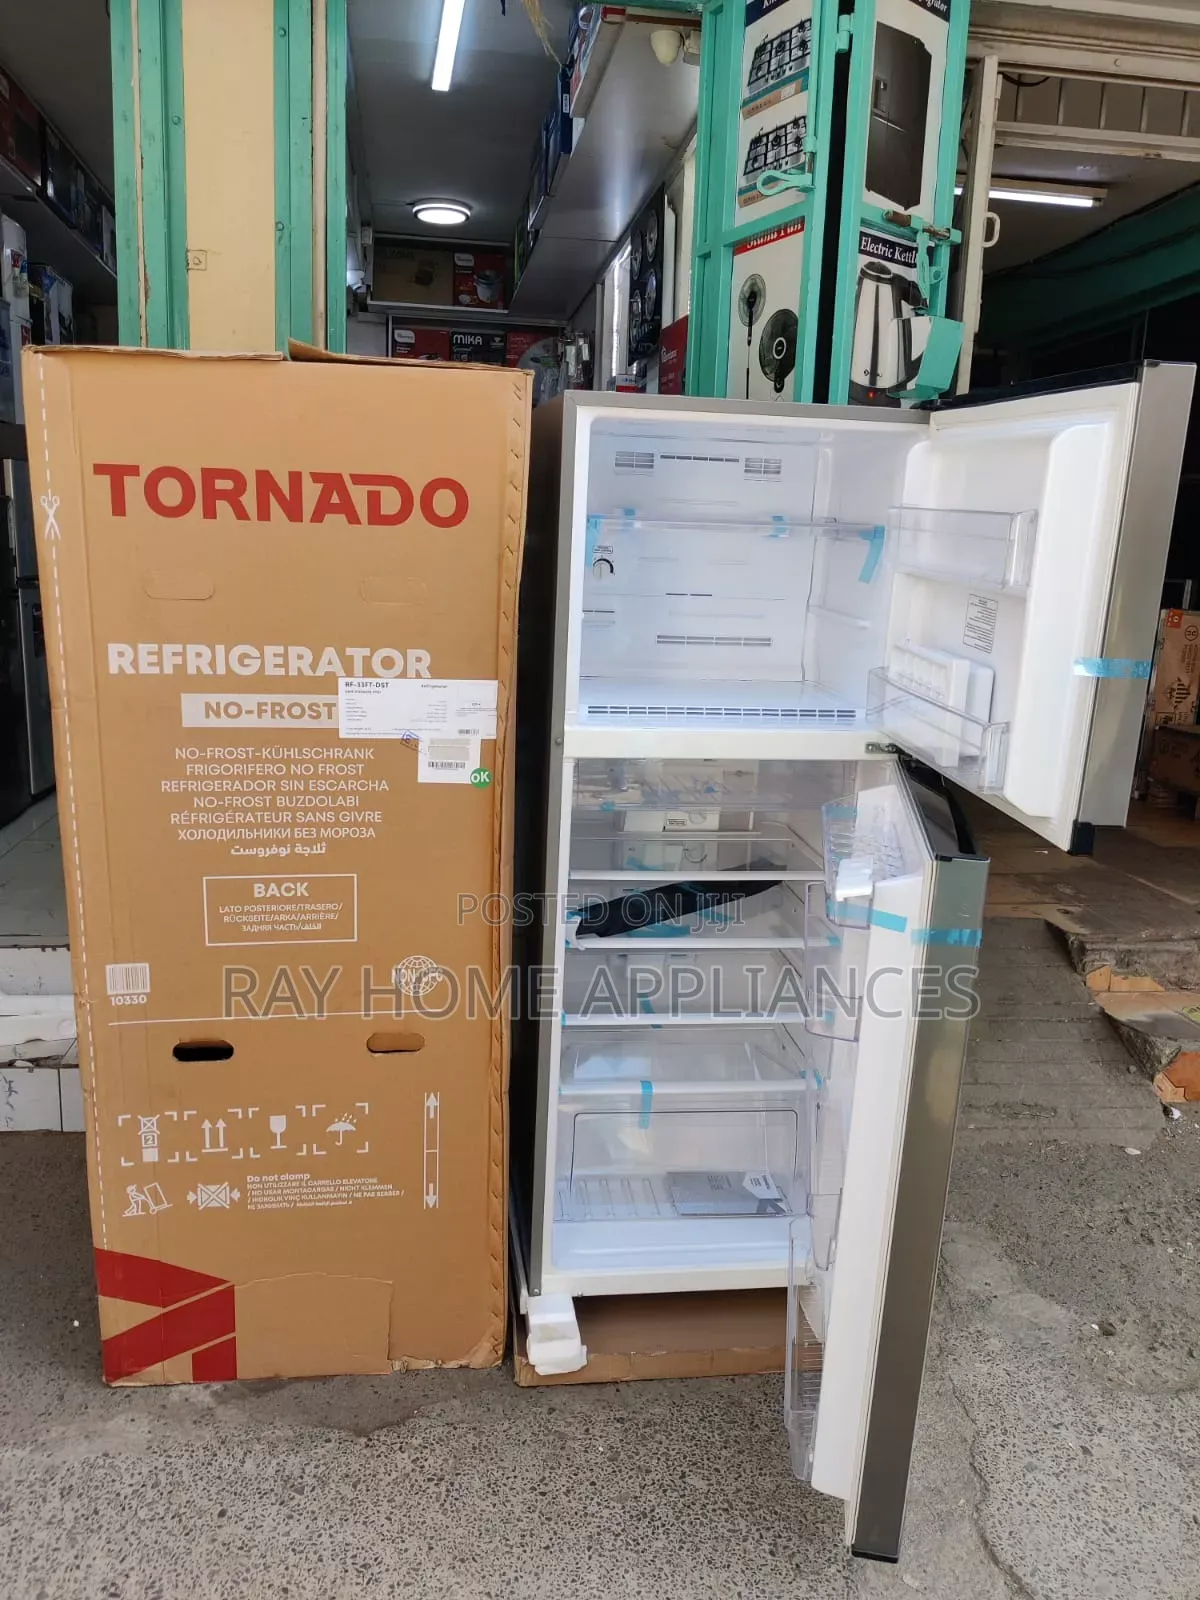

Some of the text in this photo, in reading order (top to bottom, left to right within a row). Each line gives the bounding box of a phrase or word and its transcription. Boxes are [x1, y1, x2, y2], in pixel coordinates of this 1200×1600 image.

[861, 236, 917, 264] Electric Kettl
[453, 334, 483, 345] MIKA
[93, 463, 469, 528] TORNADO
[107, 643, 432, 679] REFRIGERATOR
[204, 701, 338, 720] NO-FROST
[175, 745, 375, 760] NO-FROST-KÜHLSCHRANK
[186, 763, 365, 776] FRIGORIFERO NO FROST
[161, 779, 389, 793] REFRIGERADOR SIN ESCARCHA
[193, 796, 360, 809] NO-FROST BUZDOLABI
[170, 810, 383, 825] RÉFRIGÉRATEUR SANS GIVRE
[178, 827, 376, 842] ХОЛОДИЛЬНИКИ БЕЗ МОРОЗА
[253, 882, 309, 898] BACK
[219, 904, 242, 914] LATO
[246, 1172, 310, 1183] Do not clamp
